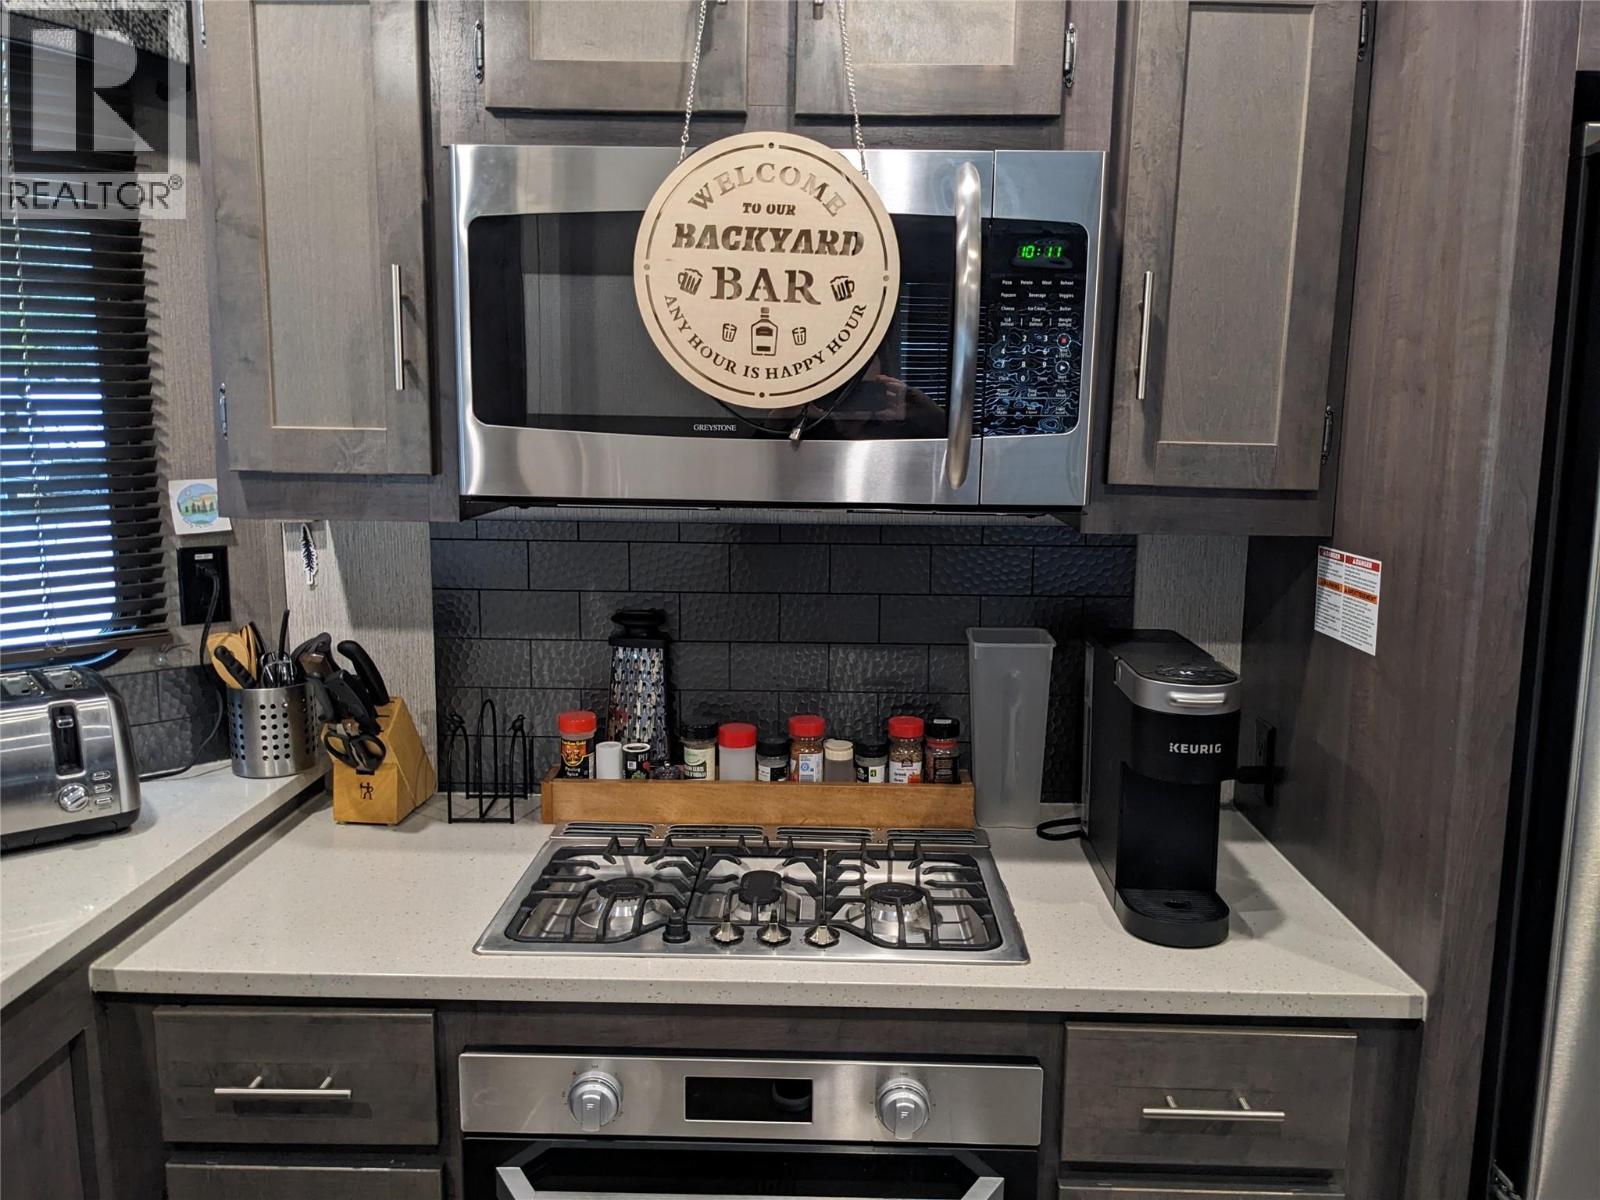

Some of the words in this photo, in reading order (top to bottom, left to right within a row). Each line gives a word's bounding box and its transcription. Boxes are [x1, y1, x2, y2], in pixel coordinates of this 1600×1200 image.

[688, 163, 847, 217] WELCOME
[742, 202, 762, 214] TO
[766, 203, 796, 216] OUR
[671, 223, 865, 256] BACKYARD
[1021, 245, 1062, 259] 10:11
[710, 266, 822, 305] BAR
[664, 294, 692, 332] ANY
[687, 333, 737, 375] HOUR
[743, 366, 760, 379] IS
[765, 350, 827, 380] HAPPY
[828, 303, 868, 355] HOUR
[1169, 742, 1222, 754] KEURIG
